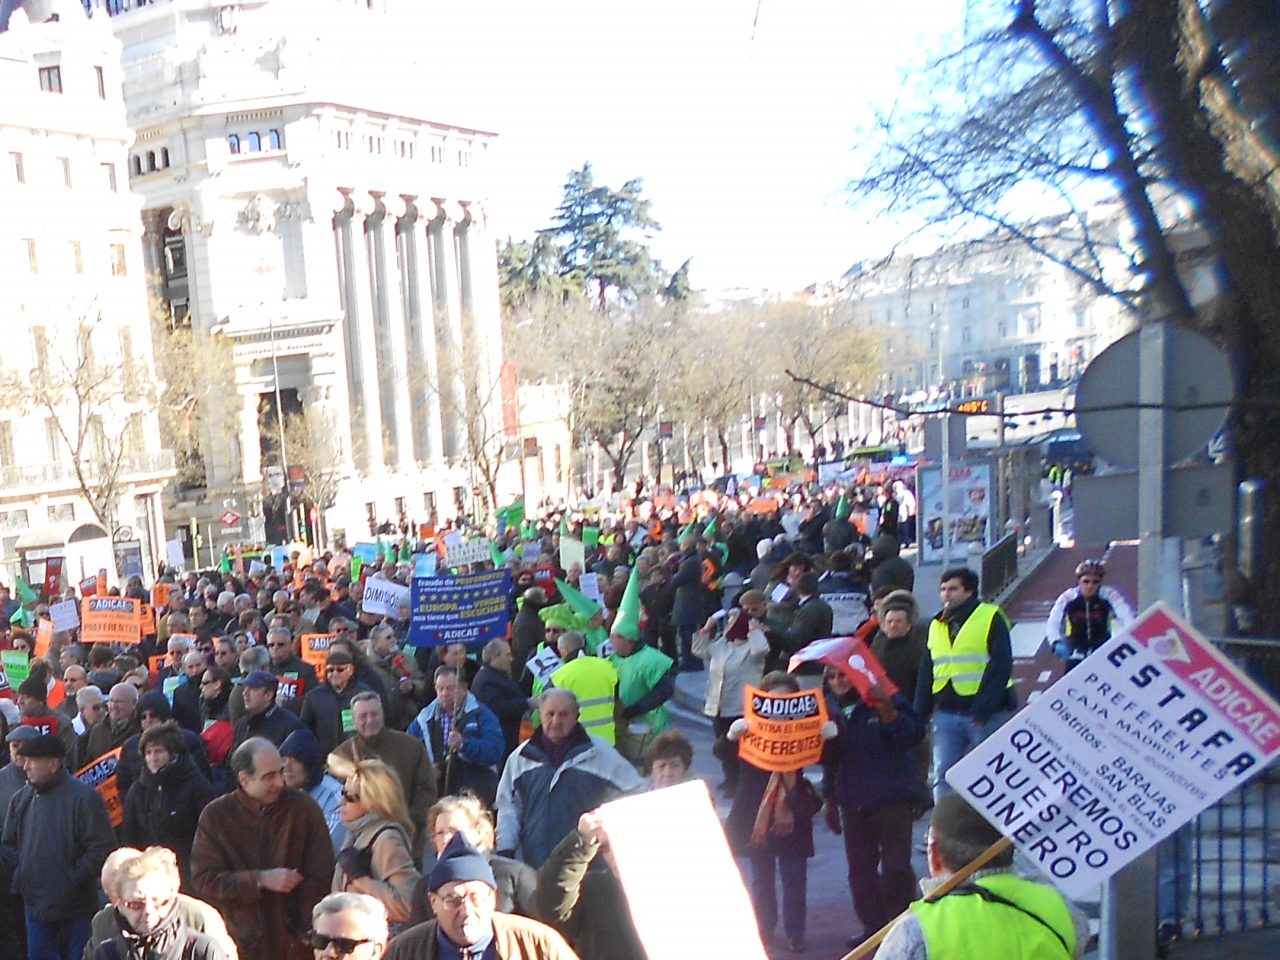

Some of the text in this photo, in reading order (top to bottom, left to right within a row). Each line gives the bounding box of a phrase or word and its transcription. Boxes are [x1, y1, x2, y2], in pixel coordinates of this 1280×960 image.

[444, 628, 478, 639] ADICAE
[743, 734, 821, 756] PREFERENTES
[760, 695, 812, 714] ADICAE
[1066, 687, 1177, 761] CAJA MADRID
[1083, 672, 1226, 781] PREFERENTES
[1107, 642, 1257, 777] ESTAFA
[1189, 667, 1279, 744] ADICAE
[1010, 728, 1138, 851] QUEREMOS
[1050, 698, 1177, 815] Distritos: BARAJAS
[1096, 764, 1167, 829] SAN BLAS
[967, 774, 1077, 879] DINERO
[987, 752, 1109, 869] NUESTRO
